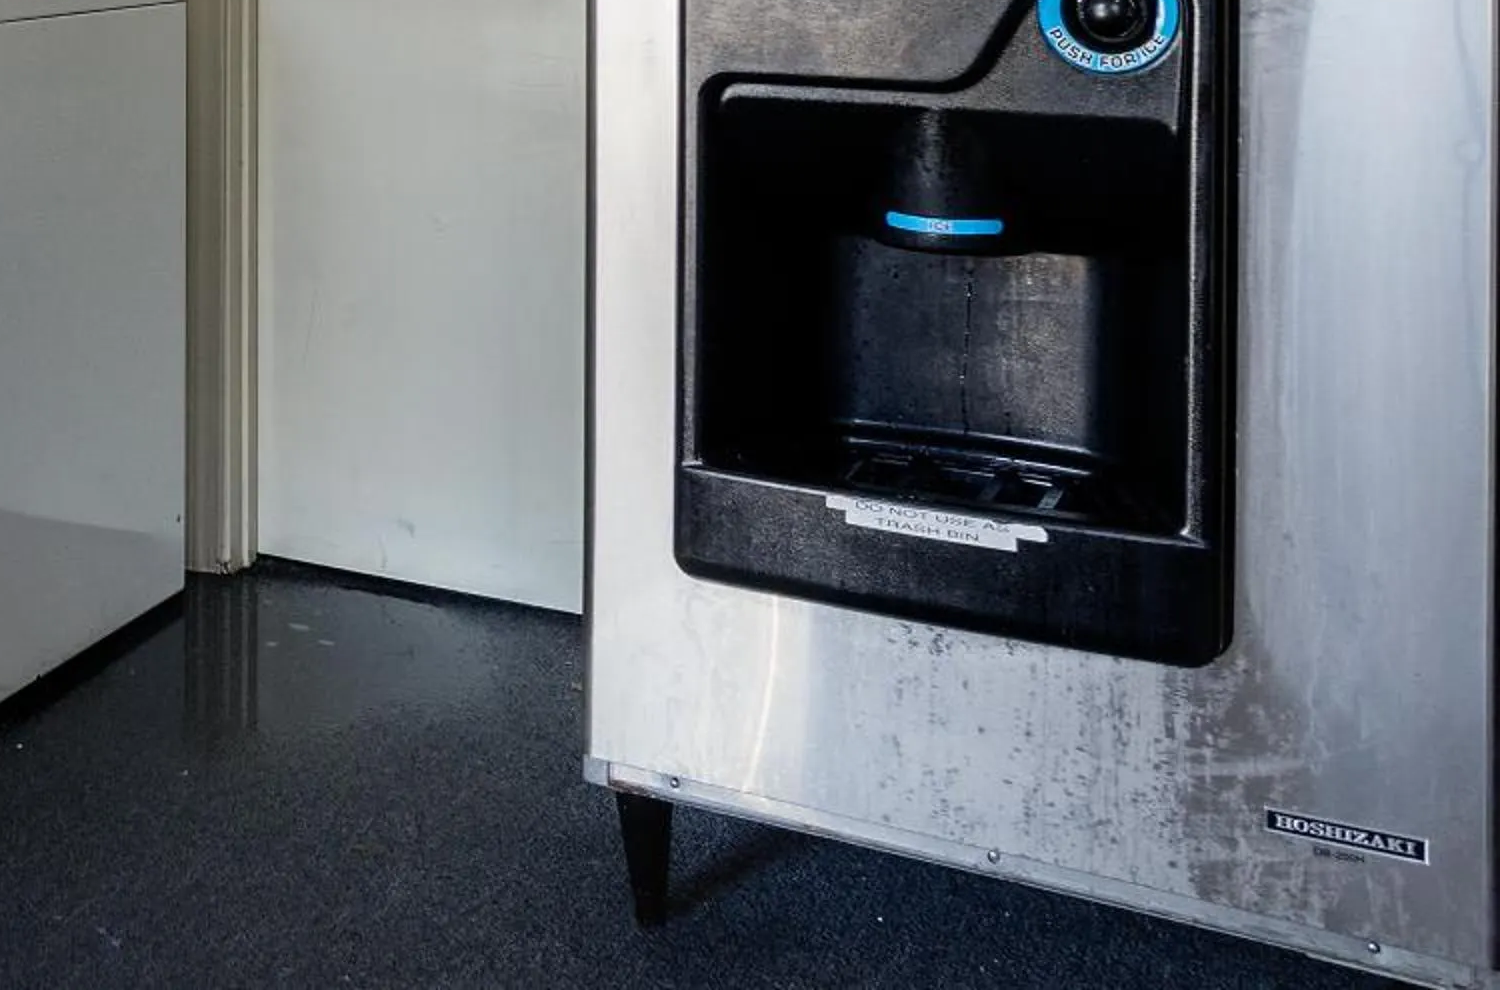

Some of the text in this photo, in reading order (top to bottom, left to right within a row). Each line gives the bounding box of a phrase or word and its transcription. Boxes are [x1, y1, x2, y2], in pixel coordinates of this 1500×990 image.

[1050, 28, 1165, 70] PUSH FOR ICE
[855, 500, 1011, 533] DO NOT USE AS
[874, 517, 980, 543] TRASH BIN
[1274, 813, 1418, 856] HOSHIZAKI
